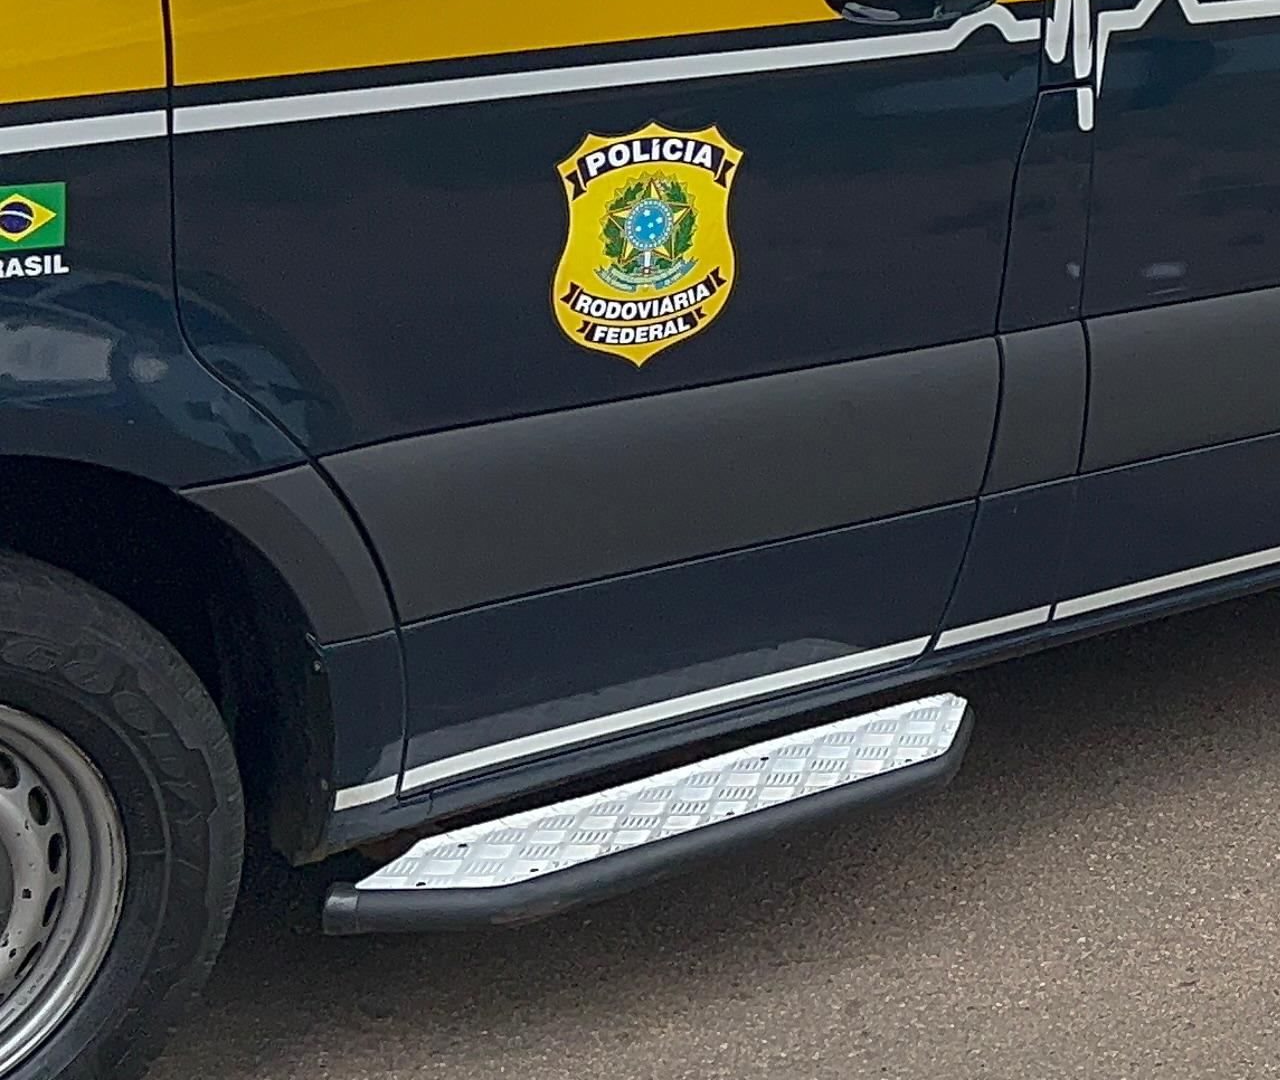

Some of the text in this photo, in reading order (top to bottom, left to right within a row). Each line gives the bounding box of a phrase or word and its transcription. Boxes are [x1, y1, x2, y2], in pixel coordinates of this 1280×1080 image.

[584, 138, 715, 178] POLÍCIA
[0, 254, 70, 278] ASIL
[575, 282, 711, 321] RODOVIÁRIA
[592, 316, 692, 345] FEDERAL
